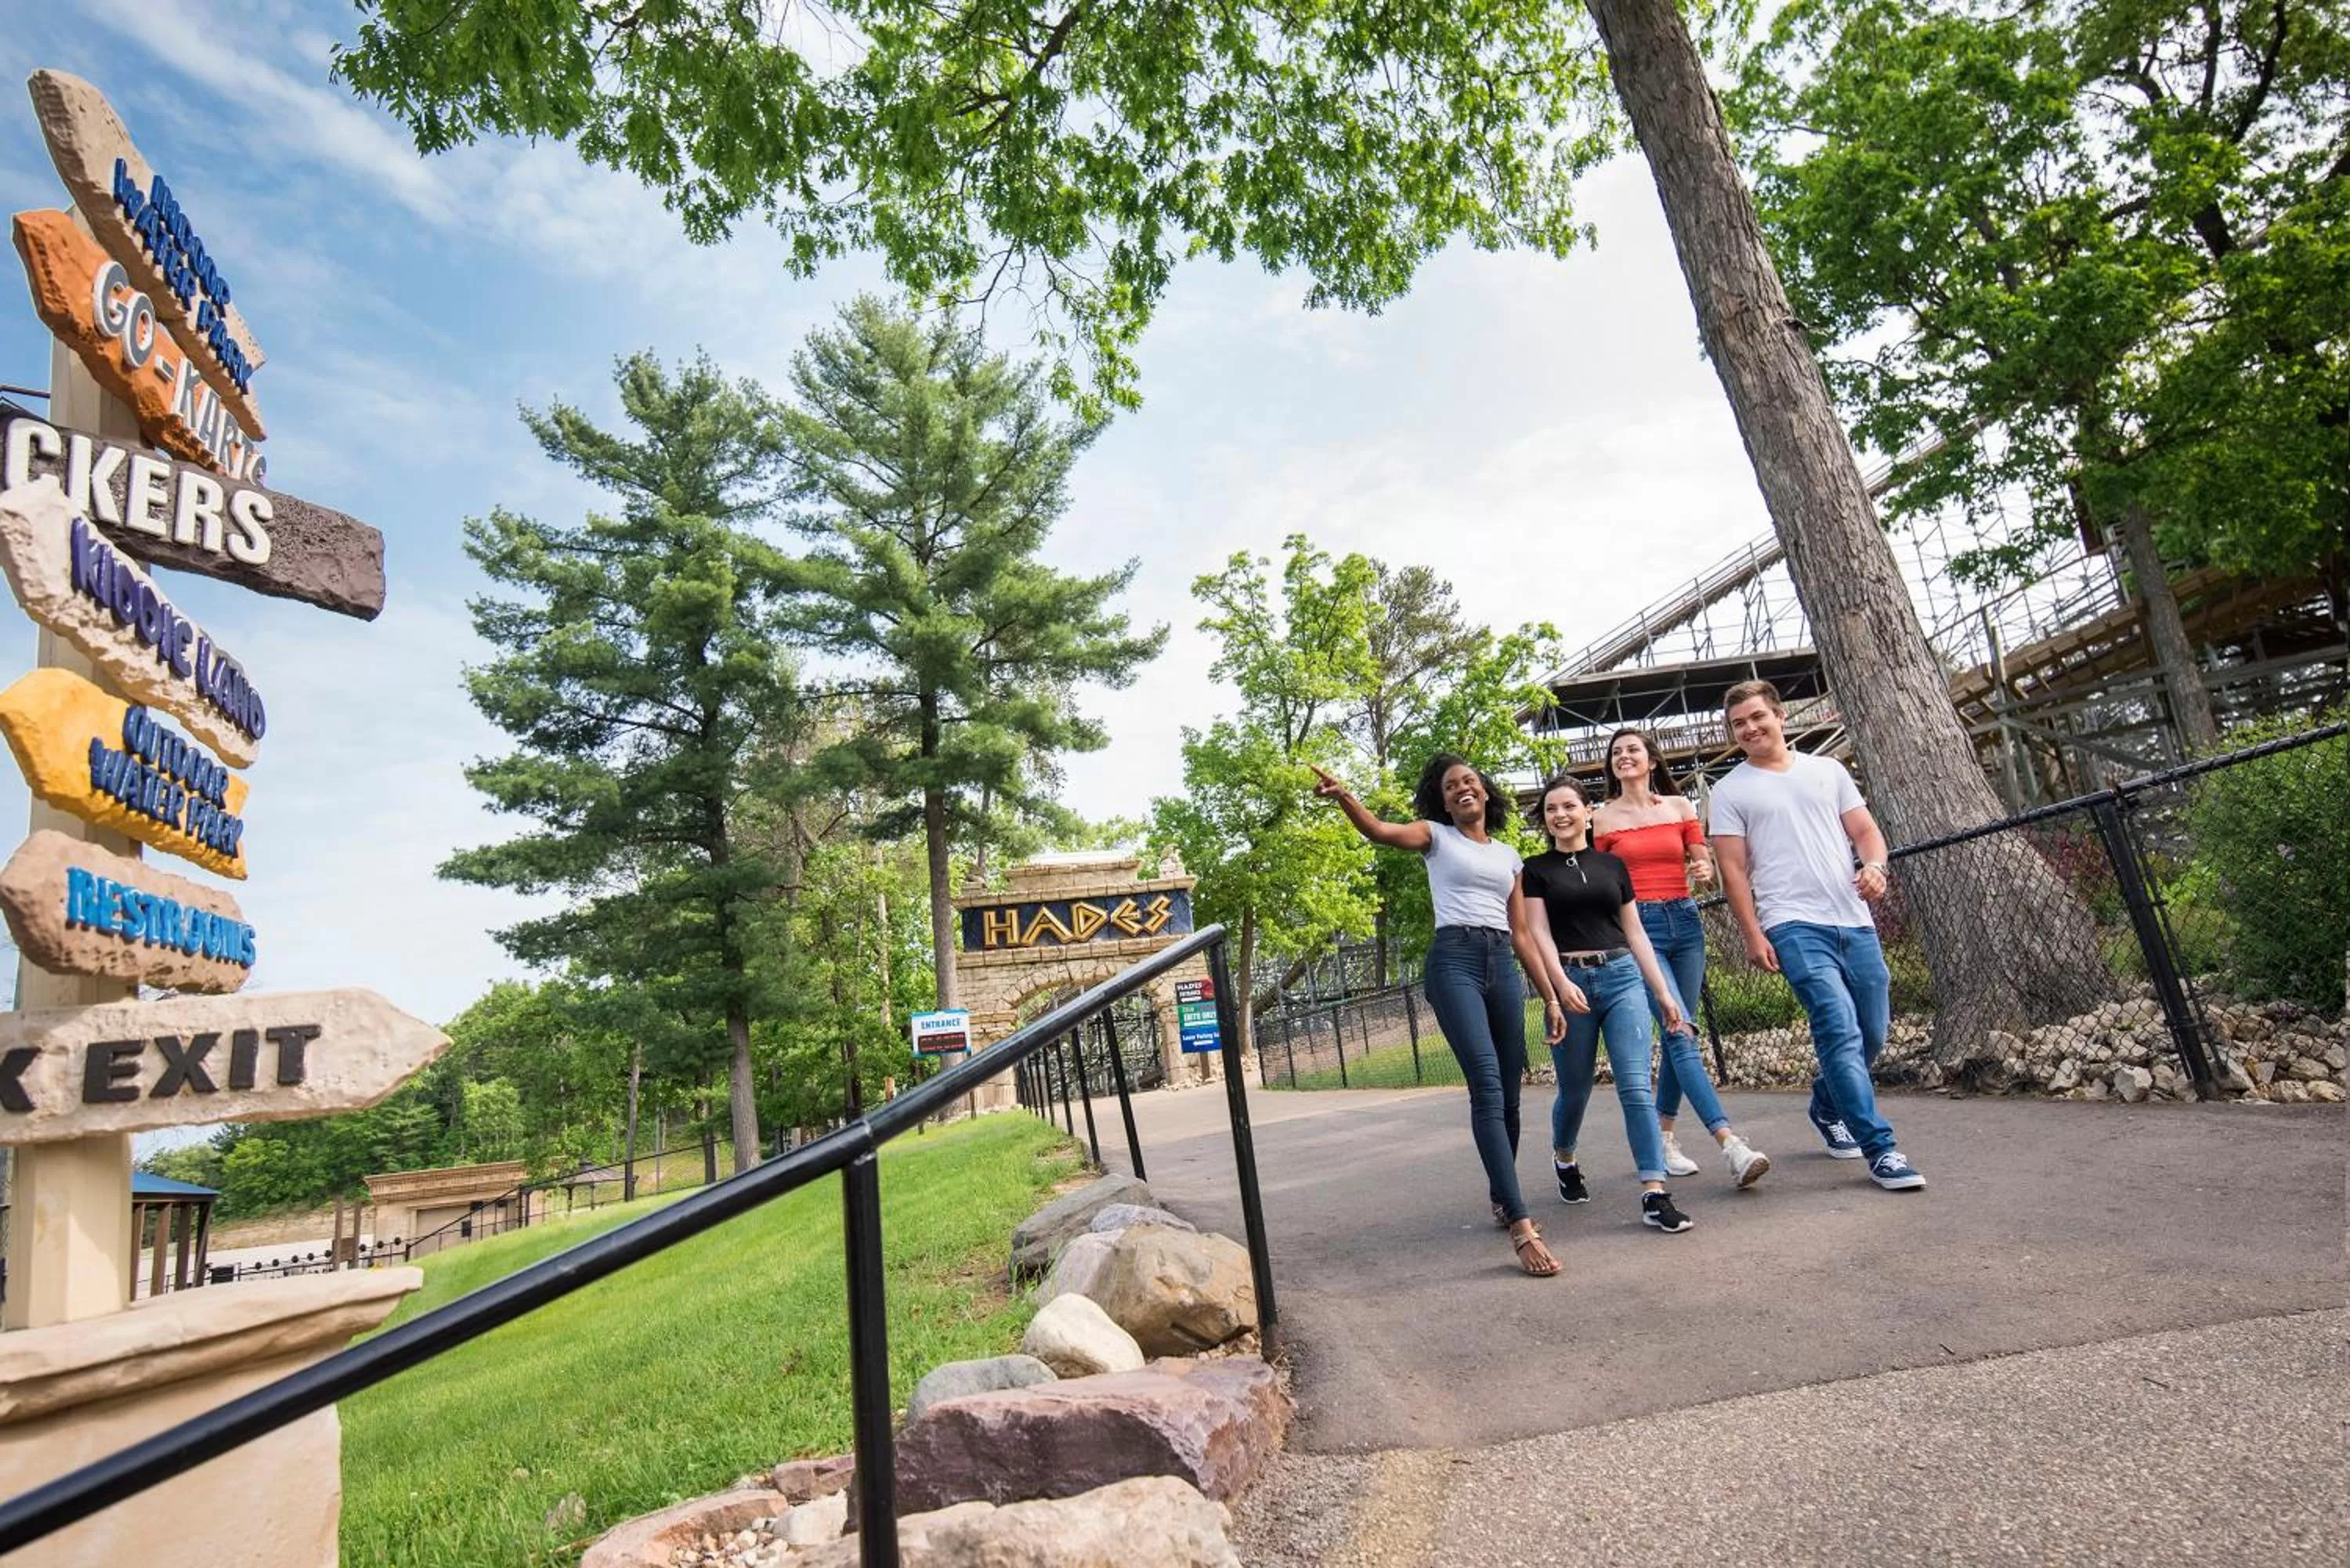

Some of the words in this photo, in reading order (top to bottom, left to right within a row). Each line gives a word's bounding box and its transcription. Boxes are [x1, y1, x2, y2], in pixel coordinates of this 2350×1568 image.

[70, 515, 193, 680] KIDDIE
[195, 636, 266, 740] LAND
[89, 737, 186, 830] WATER
[186, 796, 244, 858] PARK
[123, 705, 230, 810] OUTDOOR
[66, 866, 257, 969] RESTROOMS
[982, 894, 1174, 948] HADES
[82, 1024, 322, 1105] EXIT
[920, 1017, 962, 1030] ENTRANCE
